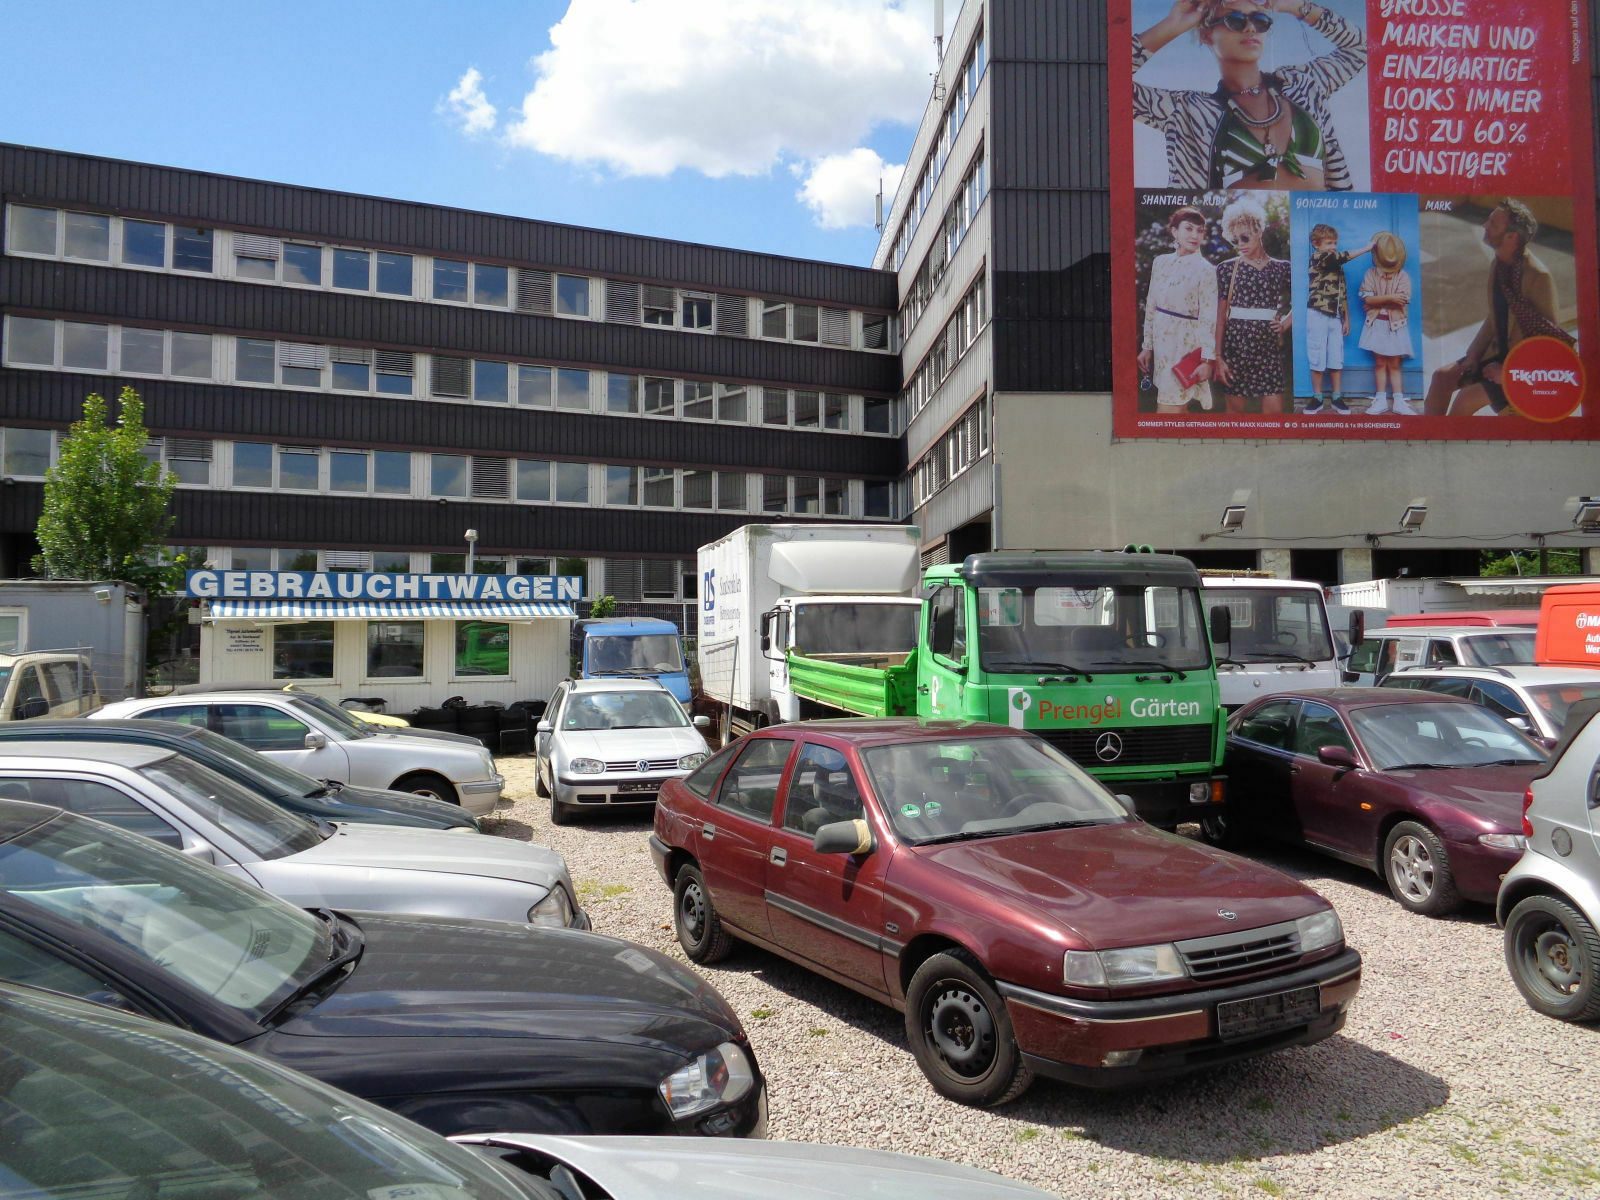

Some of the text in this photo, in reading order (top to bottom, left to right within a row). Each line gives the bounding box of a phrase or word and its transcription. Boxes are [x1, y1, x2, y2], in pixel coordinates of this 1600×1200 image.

[1381, 21, 1536, 50] MARKEN UND
[1383, 50, 1532, 83] EINZIGARTIGE
[1384, 86, 1541, 113] LOOKS IMMER
[1384, 112, 1419, 142] BIS
[1430, 119, 1463, 144] ZU
[1141, 194, 1188, 206] SHANTAEL
[1192, 196, 1199, 206] &
[1296, 198, 1377, 209] GONZALO & LUNA
[1425, 200, 1452, 211] MARK
[1239, 421, 1256, 429] MAXX
[189, 571, 580, 600] GEBRAUCHTWAGEN
[1039, 698, 1200, 725] Prengel Gärten
